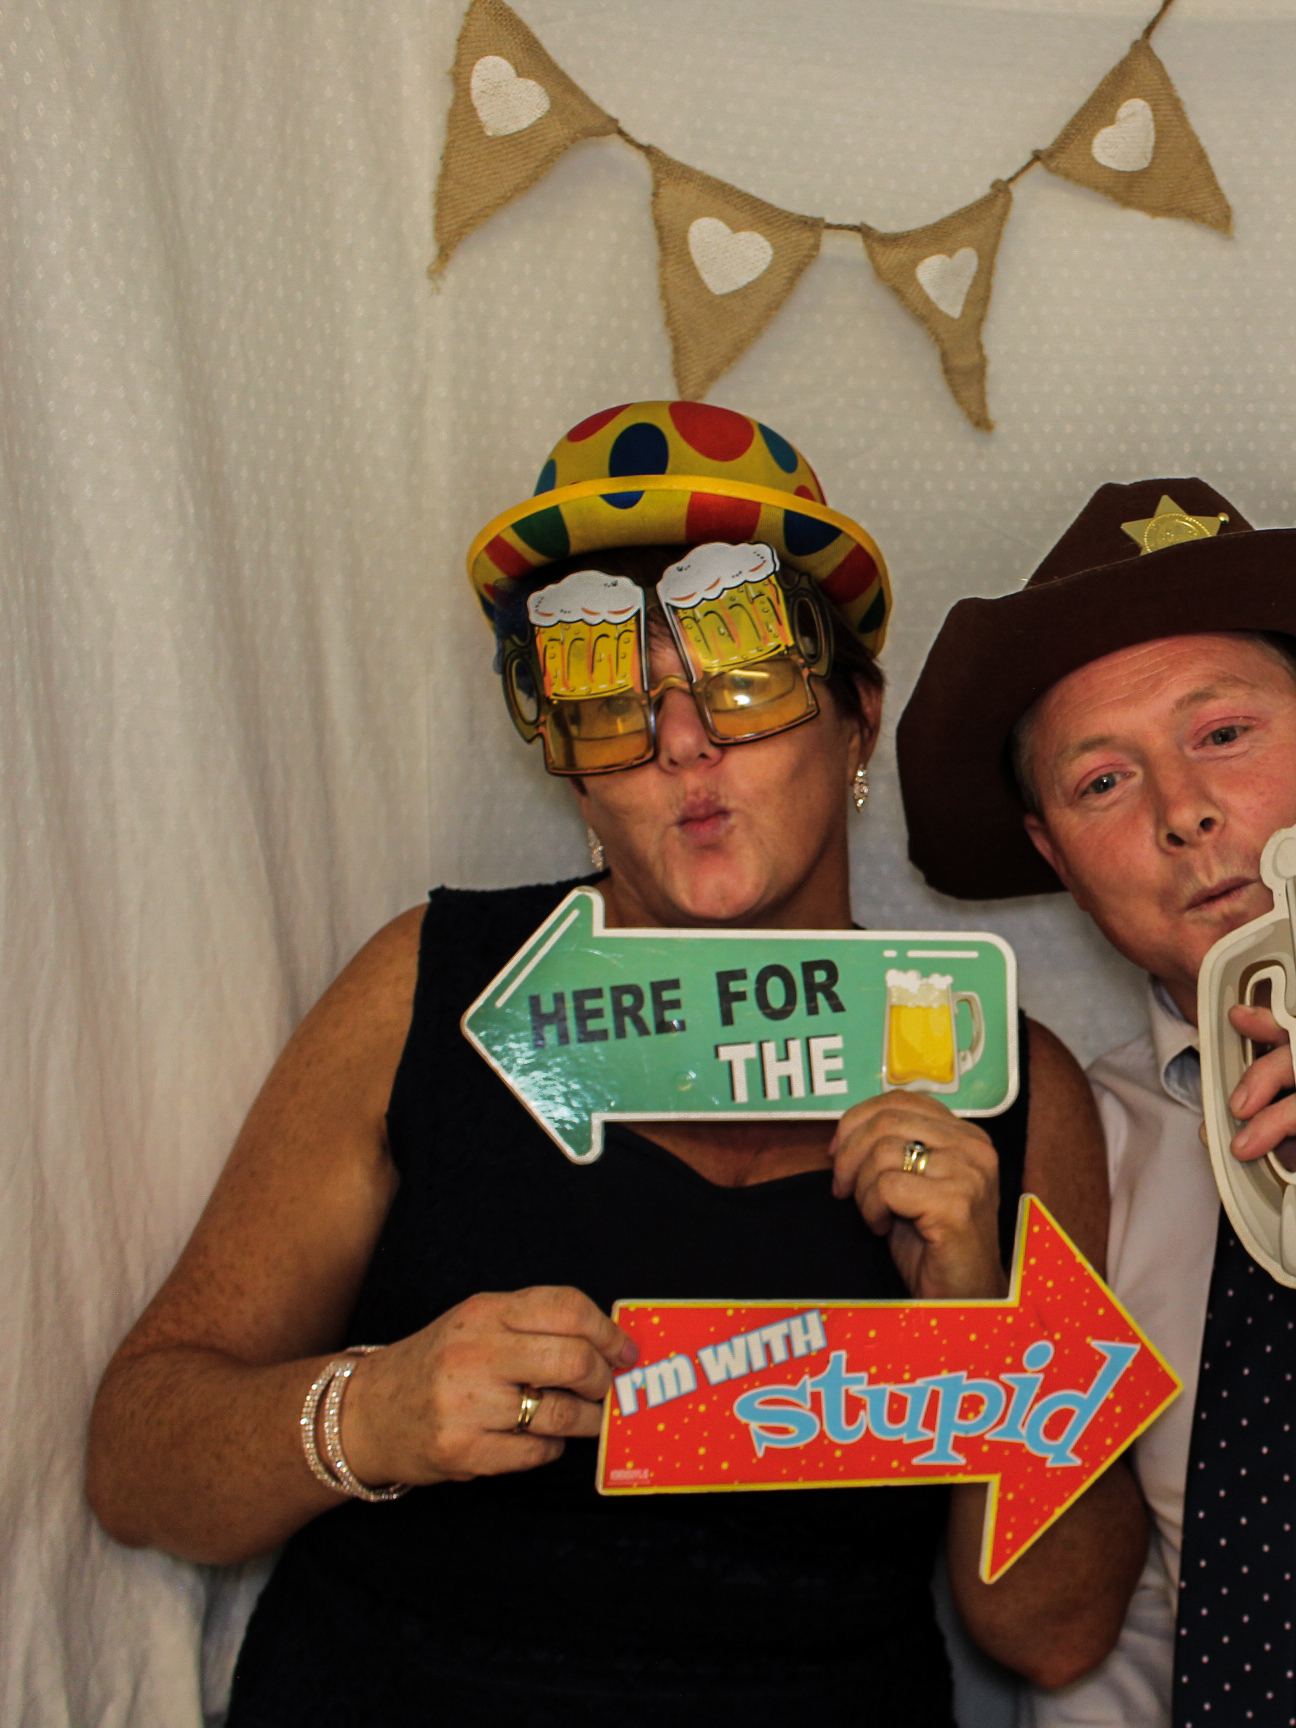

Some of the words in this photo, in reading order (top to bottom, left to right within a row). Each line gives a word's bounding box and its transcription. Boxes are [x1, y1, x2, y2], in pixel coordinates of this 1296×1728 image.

[529, 978, 687, 1049] HERE
[715, 958, 846, 1026] FOR
[716, 1034, 848, 1103] THE
[698, 1309, 827, 1385] WITH
[734, 1340, 1141, 1467] stupid
